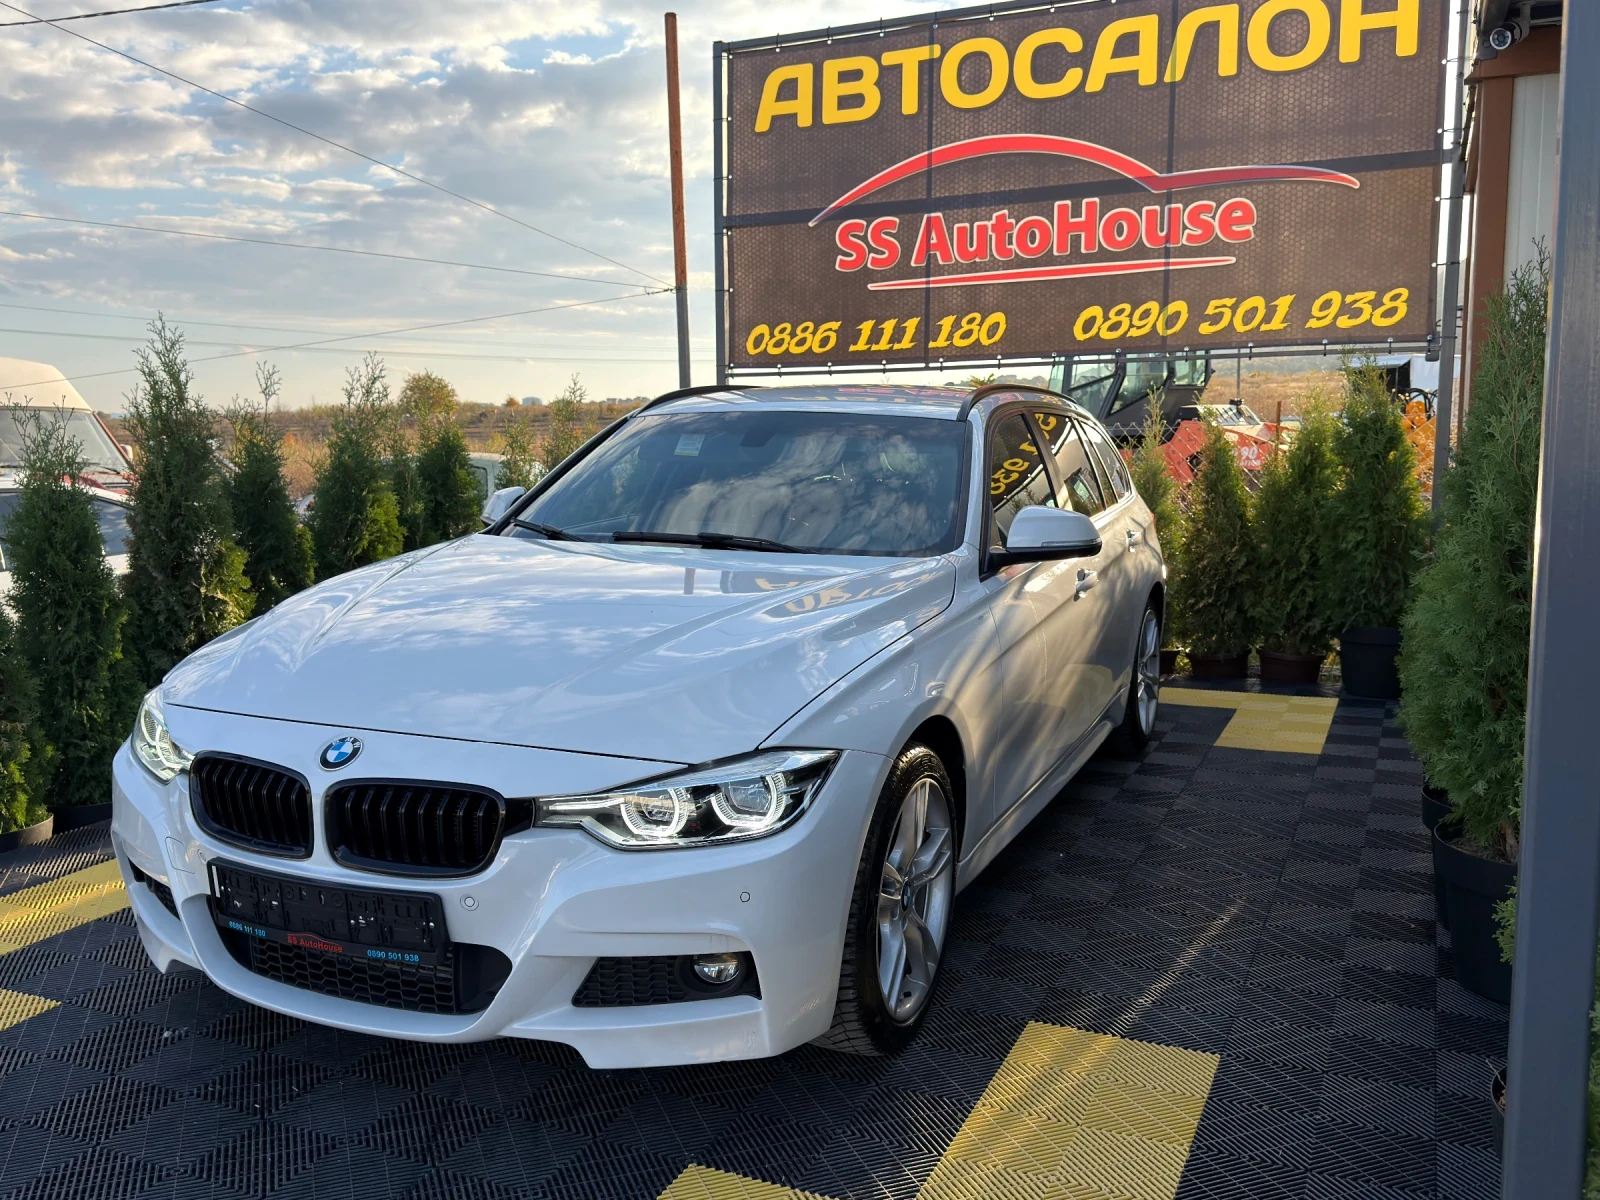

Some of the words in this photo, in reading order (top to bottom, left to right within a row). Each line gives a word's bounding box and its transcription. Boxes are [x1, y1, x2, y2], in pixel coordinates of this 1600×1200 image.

[754, 0, 1420, 133] АВТОСАЛОН
[836, 219, 900, 272] SS
[911, 198, 1257, 267] AutoHouse
[745, 320, 842, 356] 0886
[849, 318, 921, 352] 111
[928, 312, 1008, 349] 180
[1072, 300, 1190, 342] 0890
[1198, 294, 1296, 336] 501
[1305, 287, 1410, 329] 938
[244, 925, 253, 934] 111
[287, 935, 297, 945] SS
[300, 938, 343, 953] AutoHouse
[366, 949, 386, 959] 0890
[388, 952, 402, 960] 501
[404, 953, 420, 963] 938
